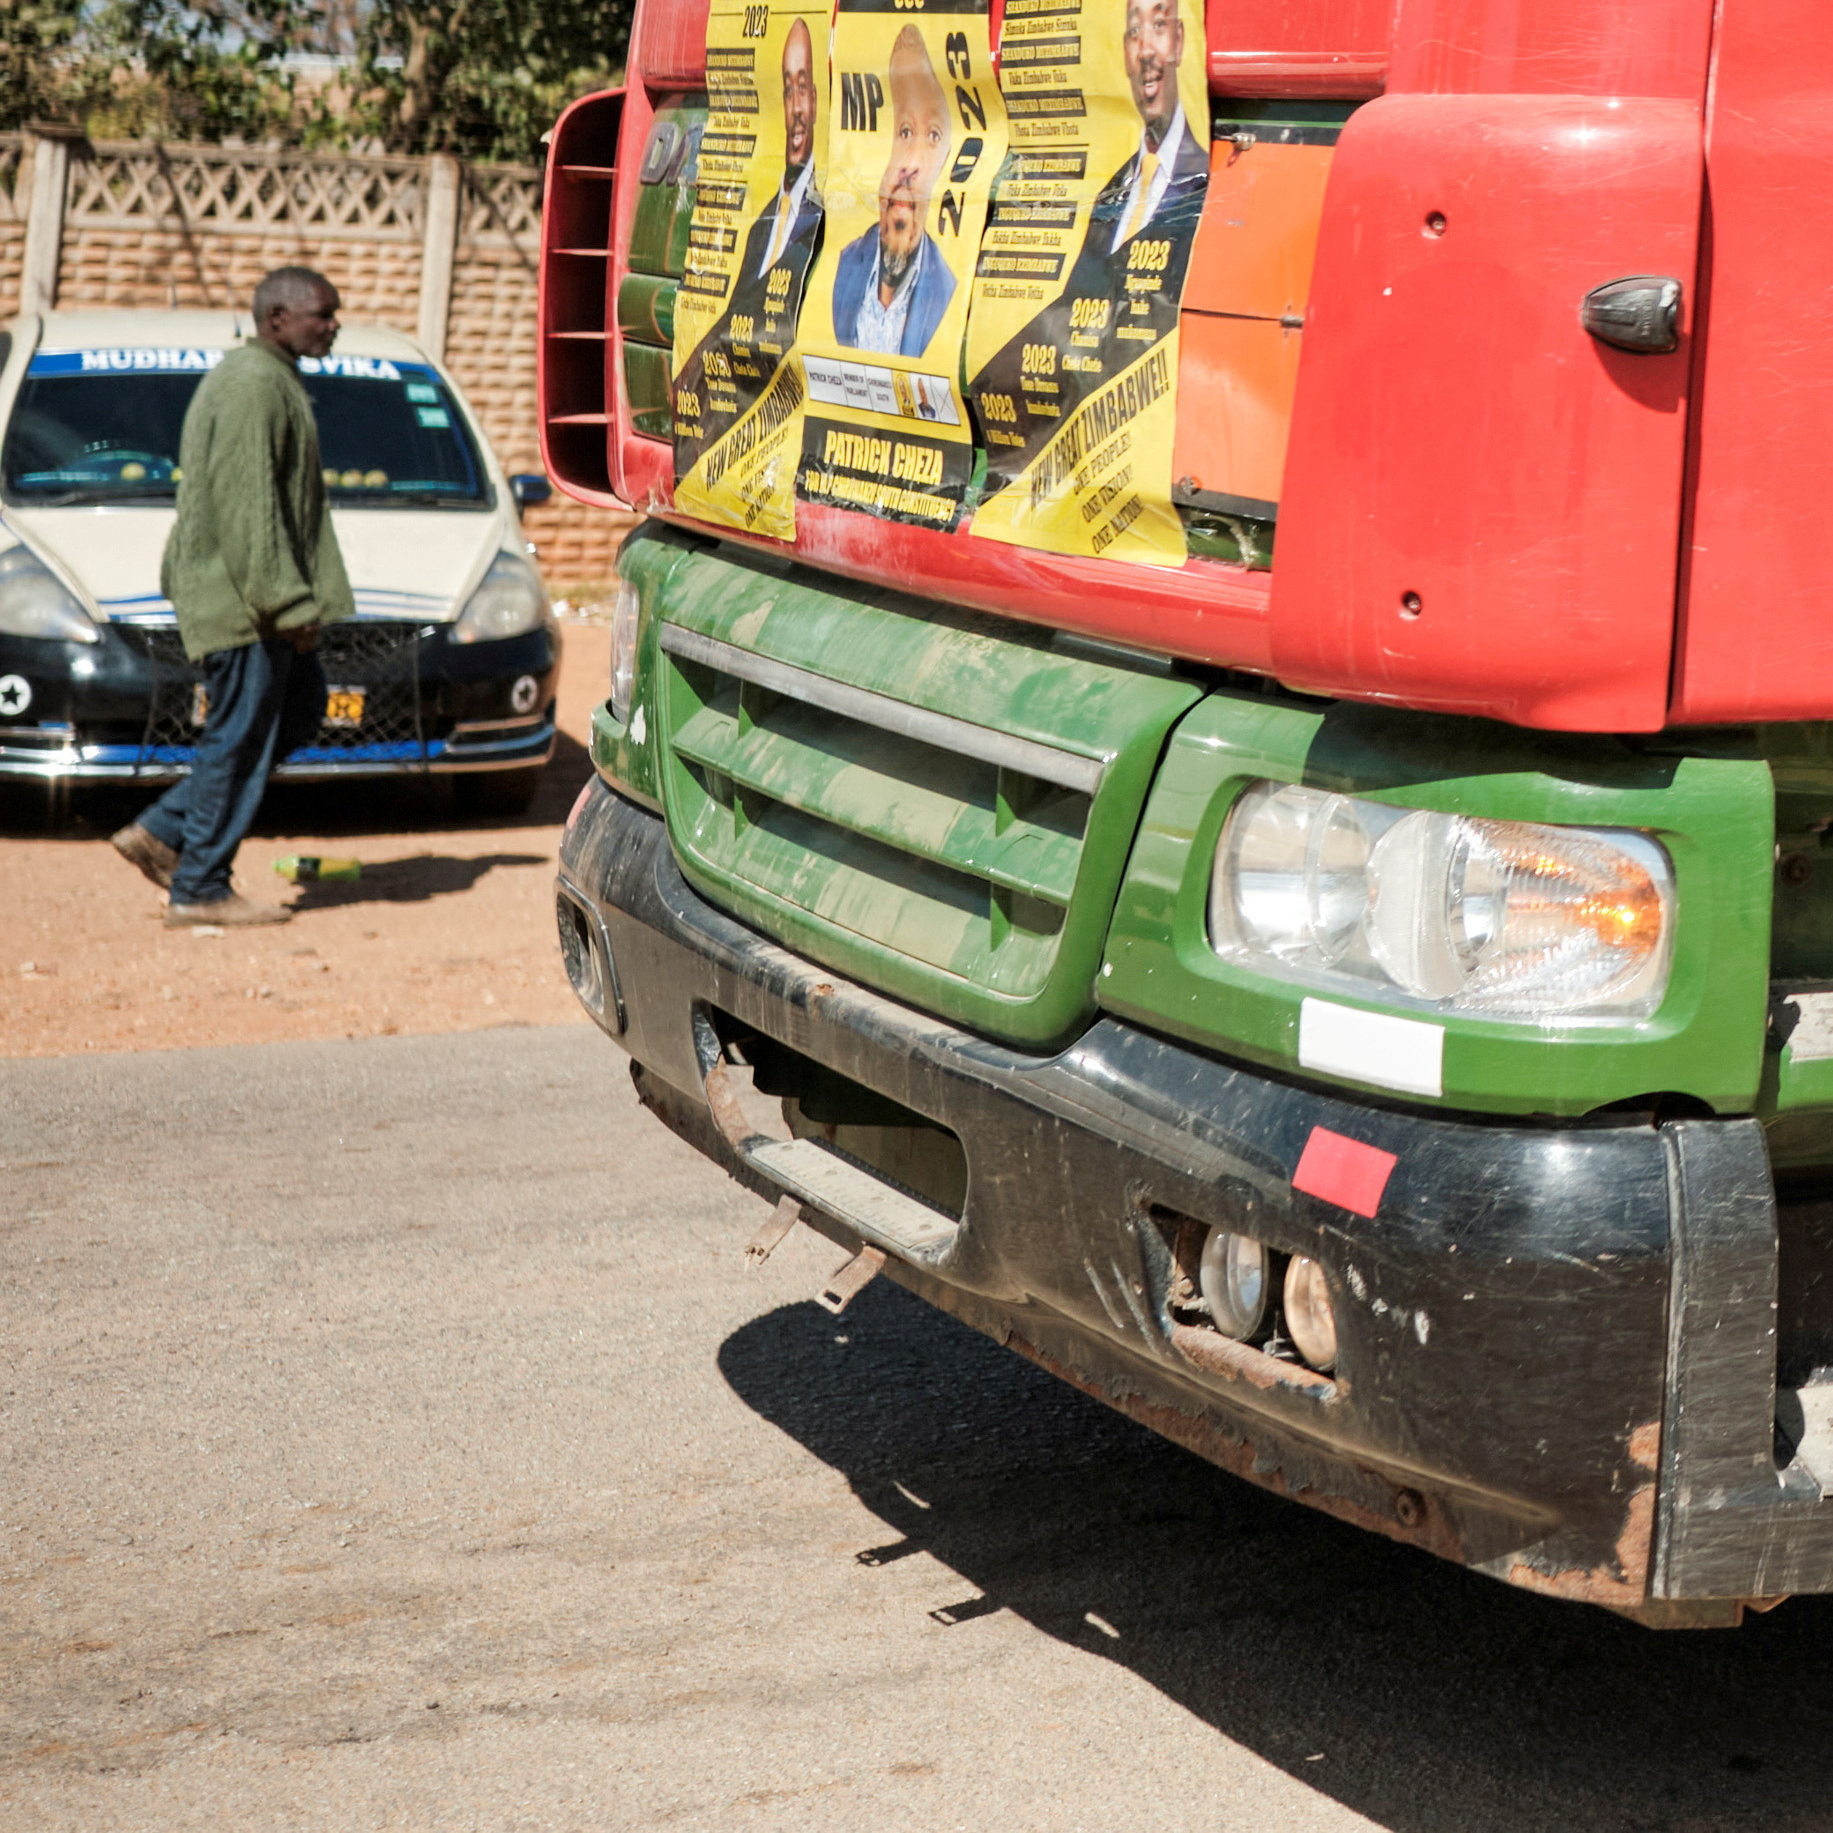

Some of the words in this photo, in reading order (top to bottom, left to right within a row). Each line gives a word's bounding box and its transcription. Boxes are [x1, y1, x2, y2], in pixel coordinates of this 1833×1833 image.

[841, 71, 884, 132] MP
[938, 31, 987, 238] 2023
[1128, 239, 1171, 271] 2023
[1069, 298, 1110, 329] 2023
[81, 348, 225, 371] MUDHAR
[299, 355, 402, 380] SVIKA
[1022, 344, 1056, 375] 2023
[981, 393, 1017, 423] 2023
[824, 430, 892, 475] PATRICK
[892, 442, 943, 486] CHEZA
